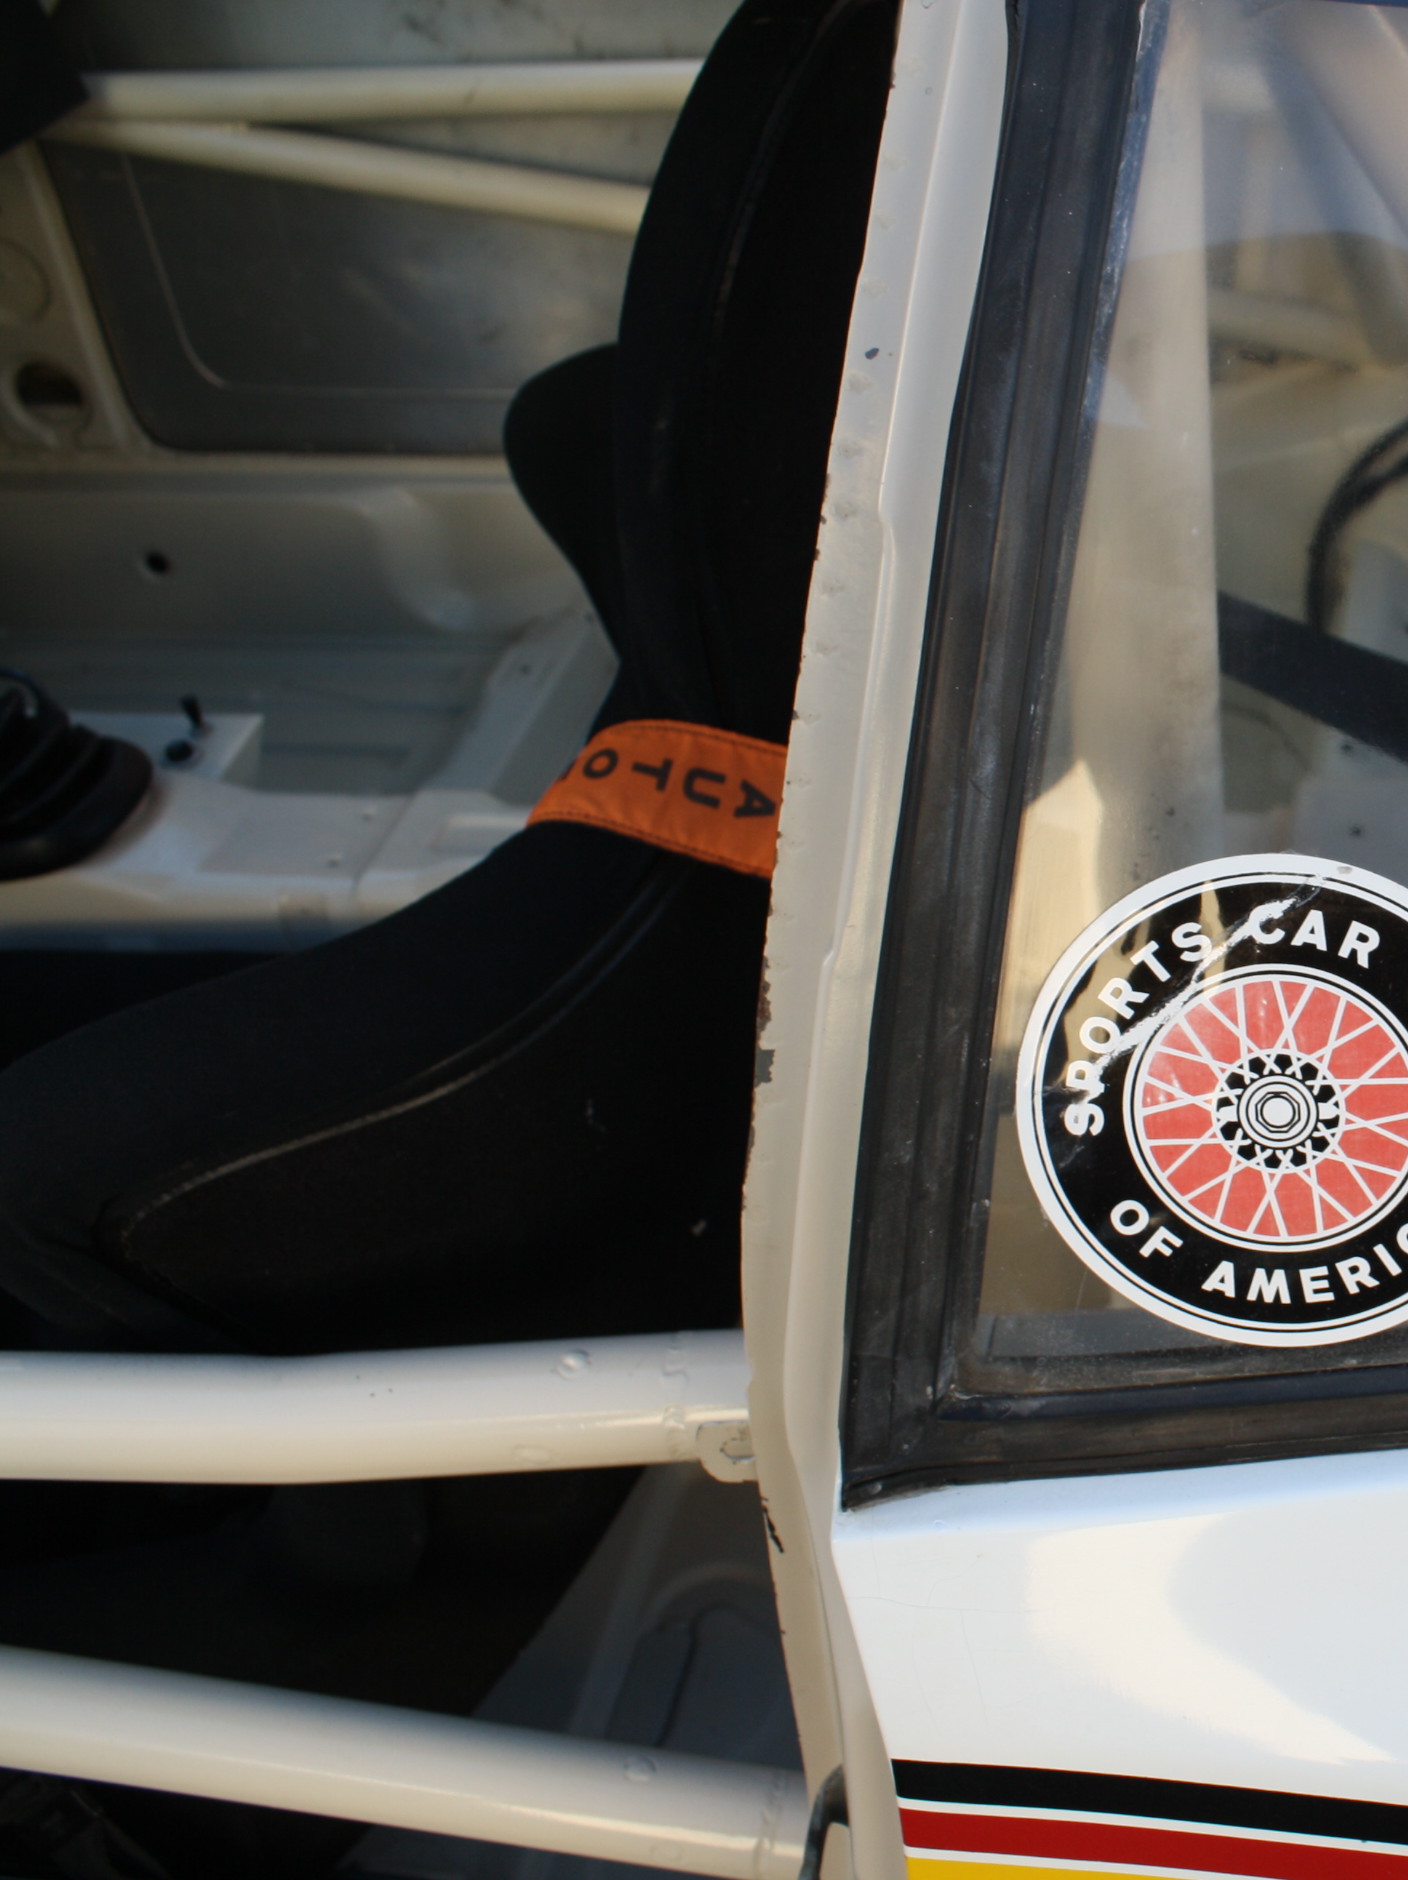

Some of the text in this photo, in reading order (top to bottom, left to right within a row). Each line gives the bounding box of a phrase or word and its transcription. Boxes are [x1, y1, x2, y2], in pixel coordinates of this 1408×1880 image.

[559, 748, 776, 818] AUTO
[1065, 921, 1212, 1136] SPORTS
[1248, 903, 1380, 967] CAR
[1110, 1200, 1184, 1259] OF
